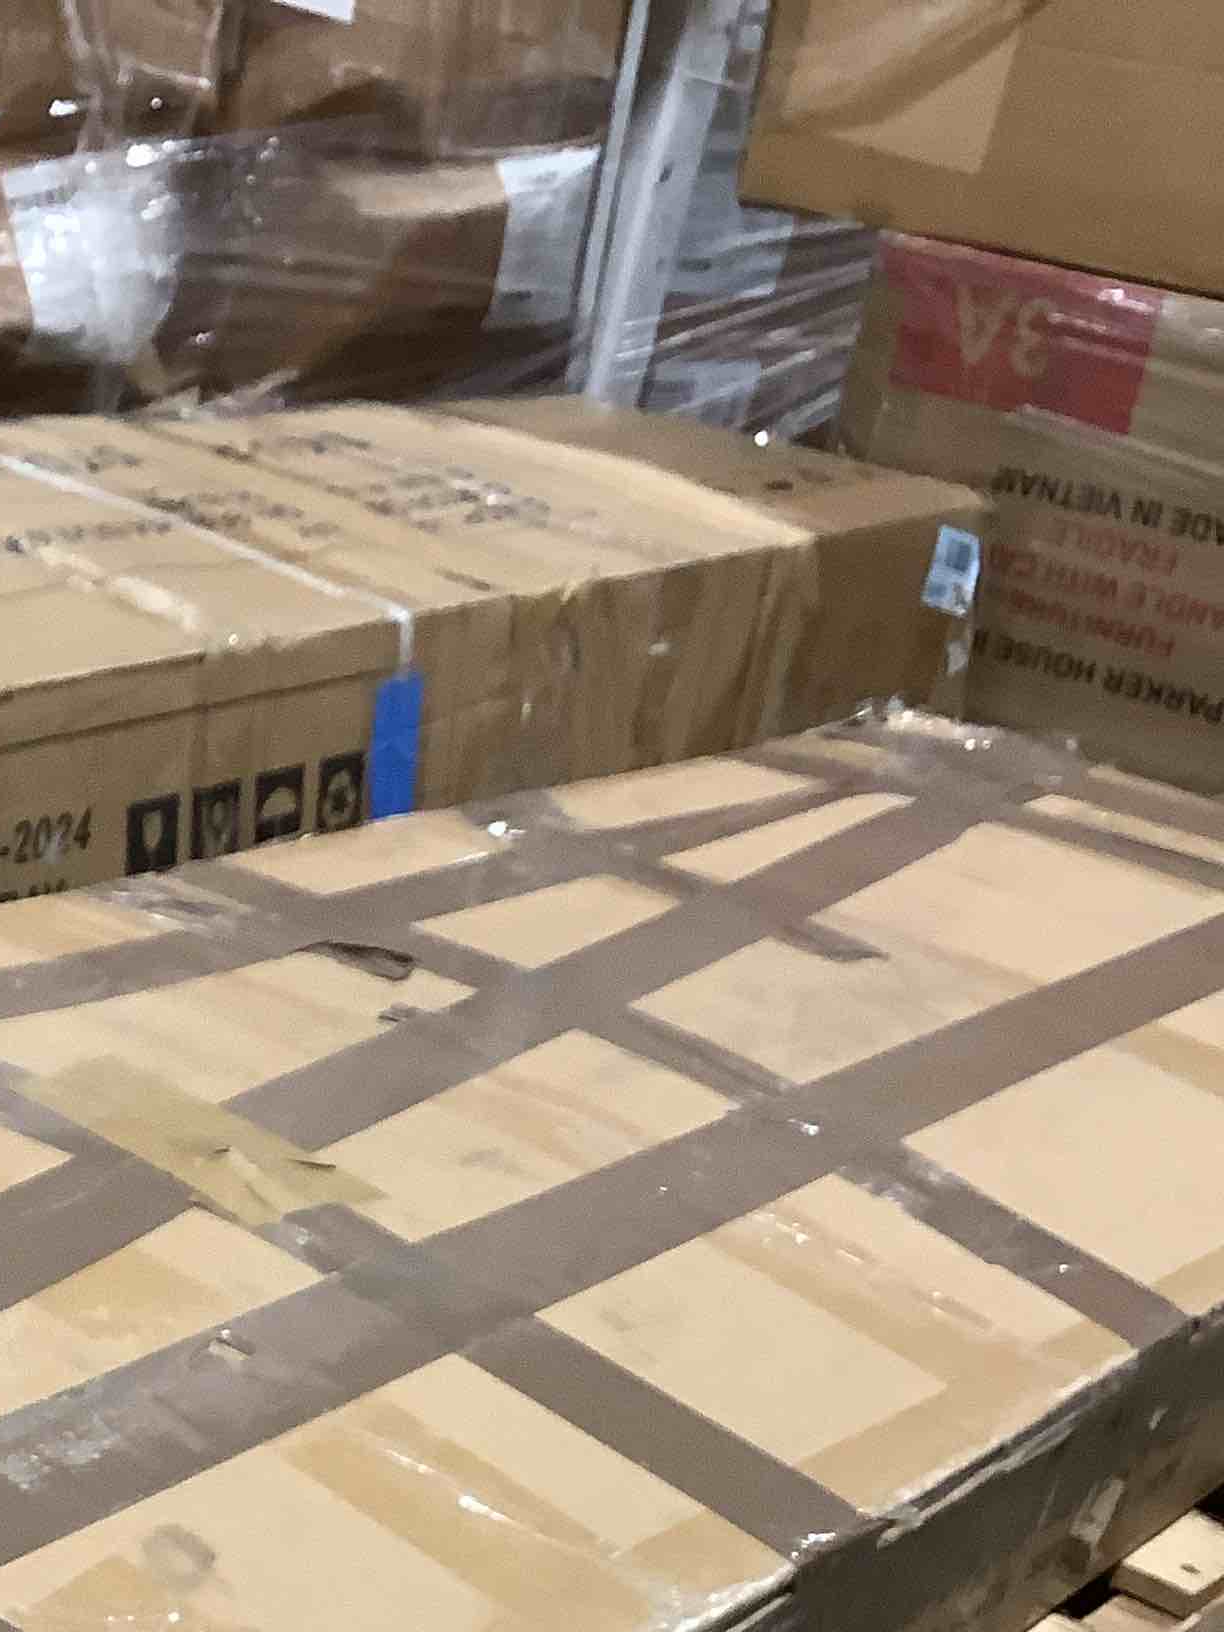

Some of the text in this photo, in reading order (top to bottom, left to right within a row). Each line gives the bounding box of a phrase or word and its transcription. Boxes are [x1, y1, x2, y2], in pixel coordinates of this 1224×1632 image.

[990, 466, 1125, 520] VIETNAM
[1130, 498, 1164, 529] IN
[993, 634, 1097, 684] HOUSE
